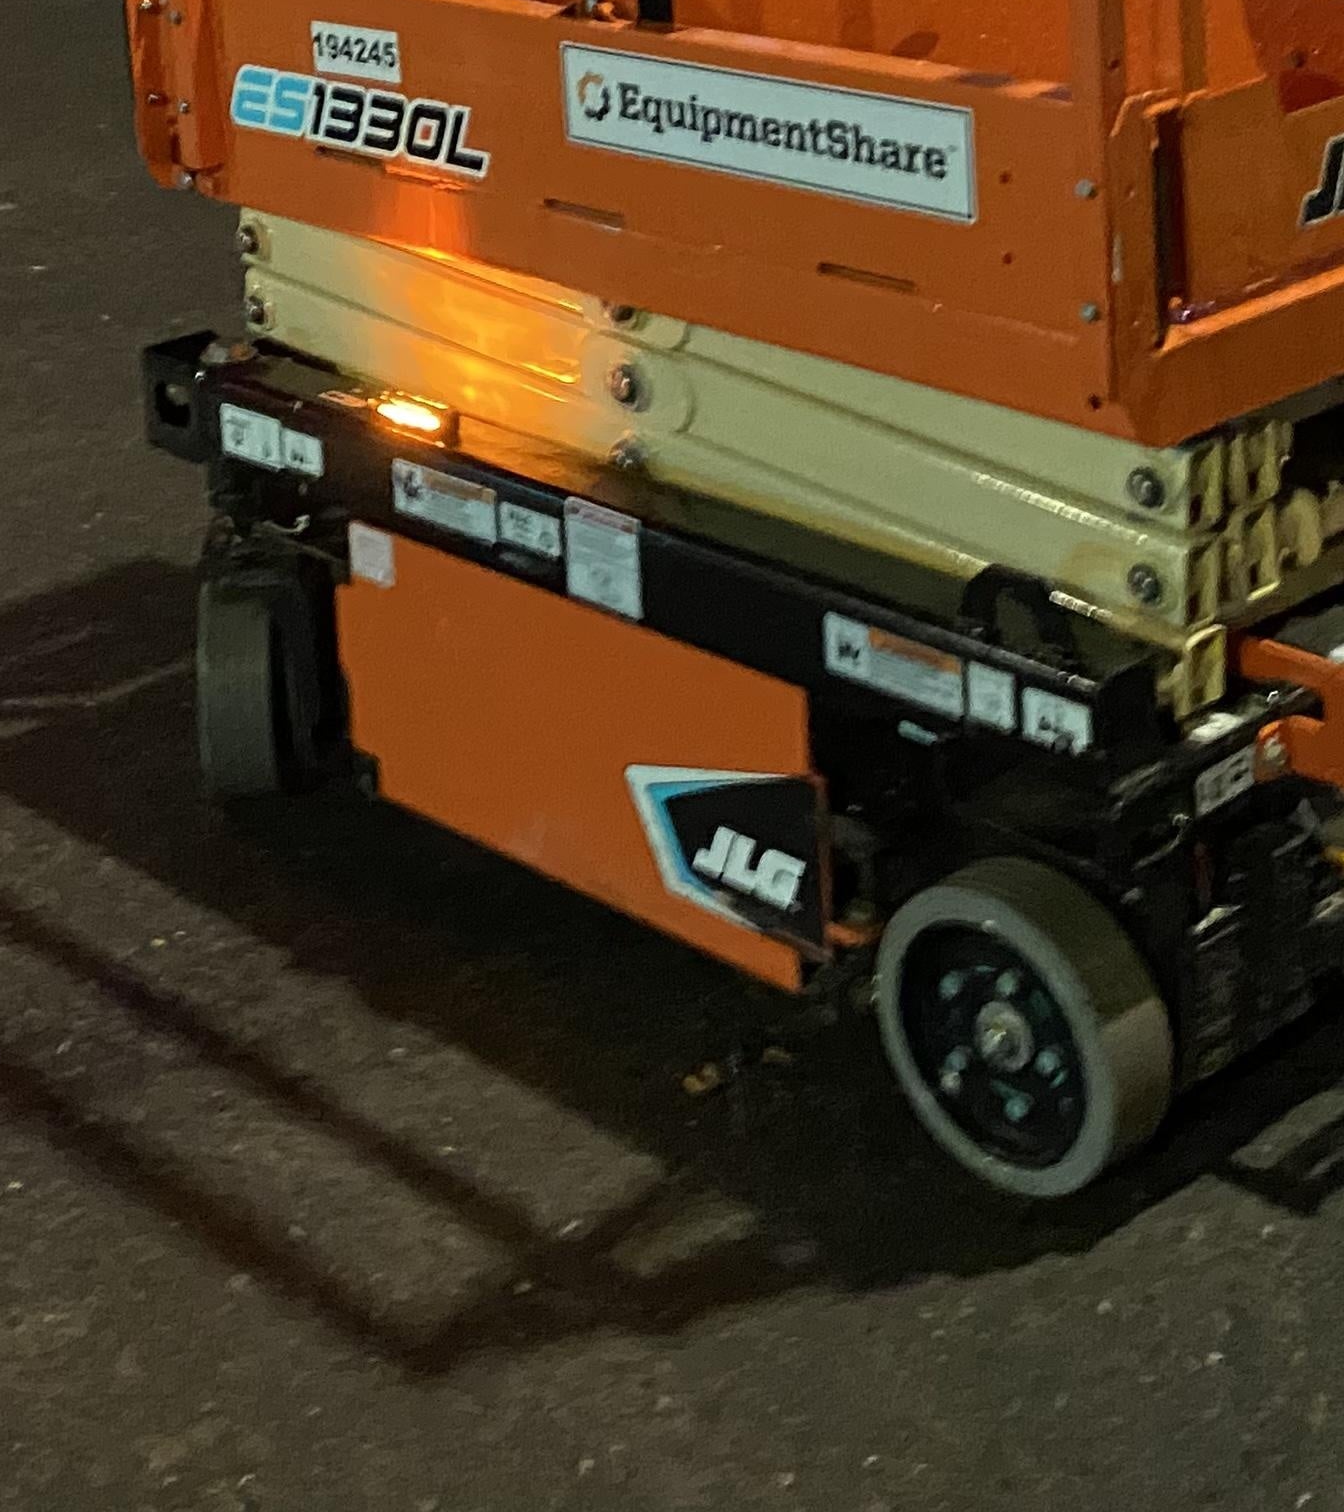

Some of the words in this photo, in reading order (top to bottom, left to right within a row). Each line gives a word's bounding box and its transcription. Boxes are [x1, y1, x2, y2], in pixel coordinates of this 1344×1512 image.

[312, 31, 397, 68] 194245
[231, 66, 490, 176] ES1330L
[617, 81, 947, 180] EquipmentShare
[692, 825, 807, 910] JLG
